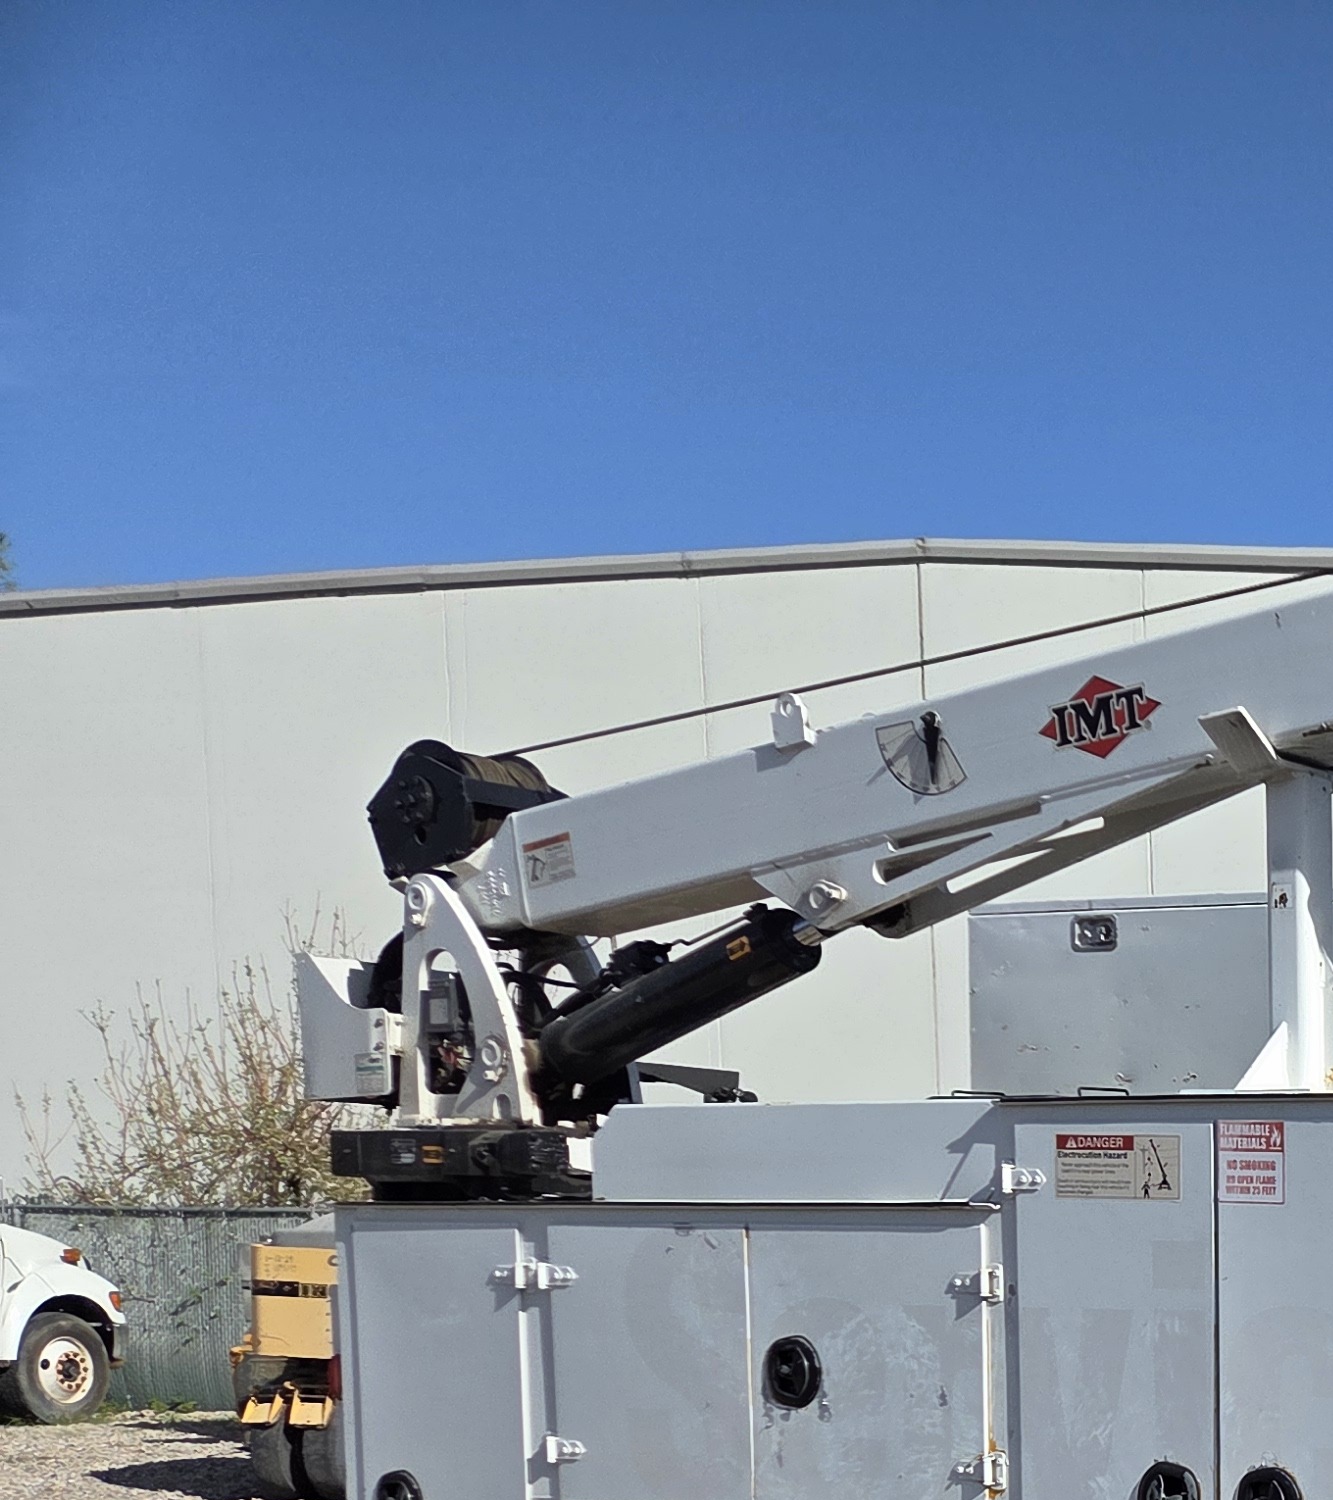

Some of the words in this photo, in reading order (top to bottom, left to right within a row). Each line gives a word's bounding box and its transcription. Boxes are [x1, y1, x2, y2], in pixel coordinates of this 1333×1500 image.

[1050, 685, 1147, 749] IMT
[1220, 1124, 1270, 1136] FLAMMABLE
[1077, 1136, 1124, 1149] DANGER
[1220, 1137, 1266, 1149] MATERIALS
[1057, 1150, 1102, 1159] Electrocution
[1103, 1151, 1128, 1160] Hazard
[1226, 1159, 1237, 1170] NO
[1239, 1159, 1276, 1171] SMOKING
[1237, 1175, 1254, 1184] OPEN
[1255, 1175, 1277, 1185] FLAME
[1262, 1186, 1277, 1196] FEET
